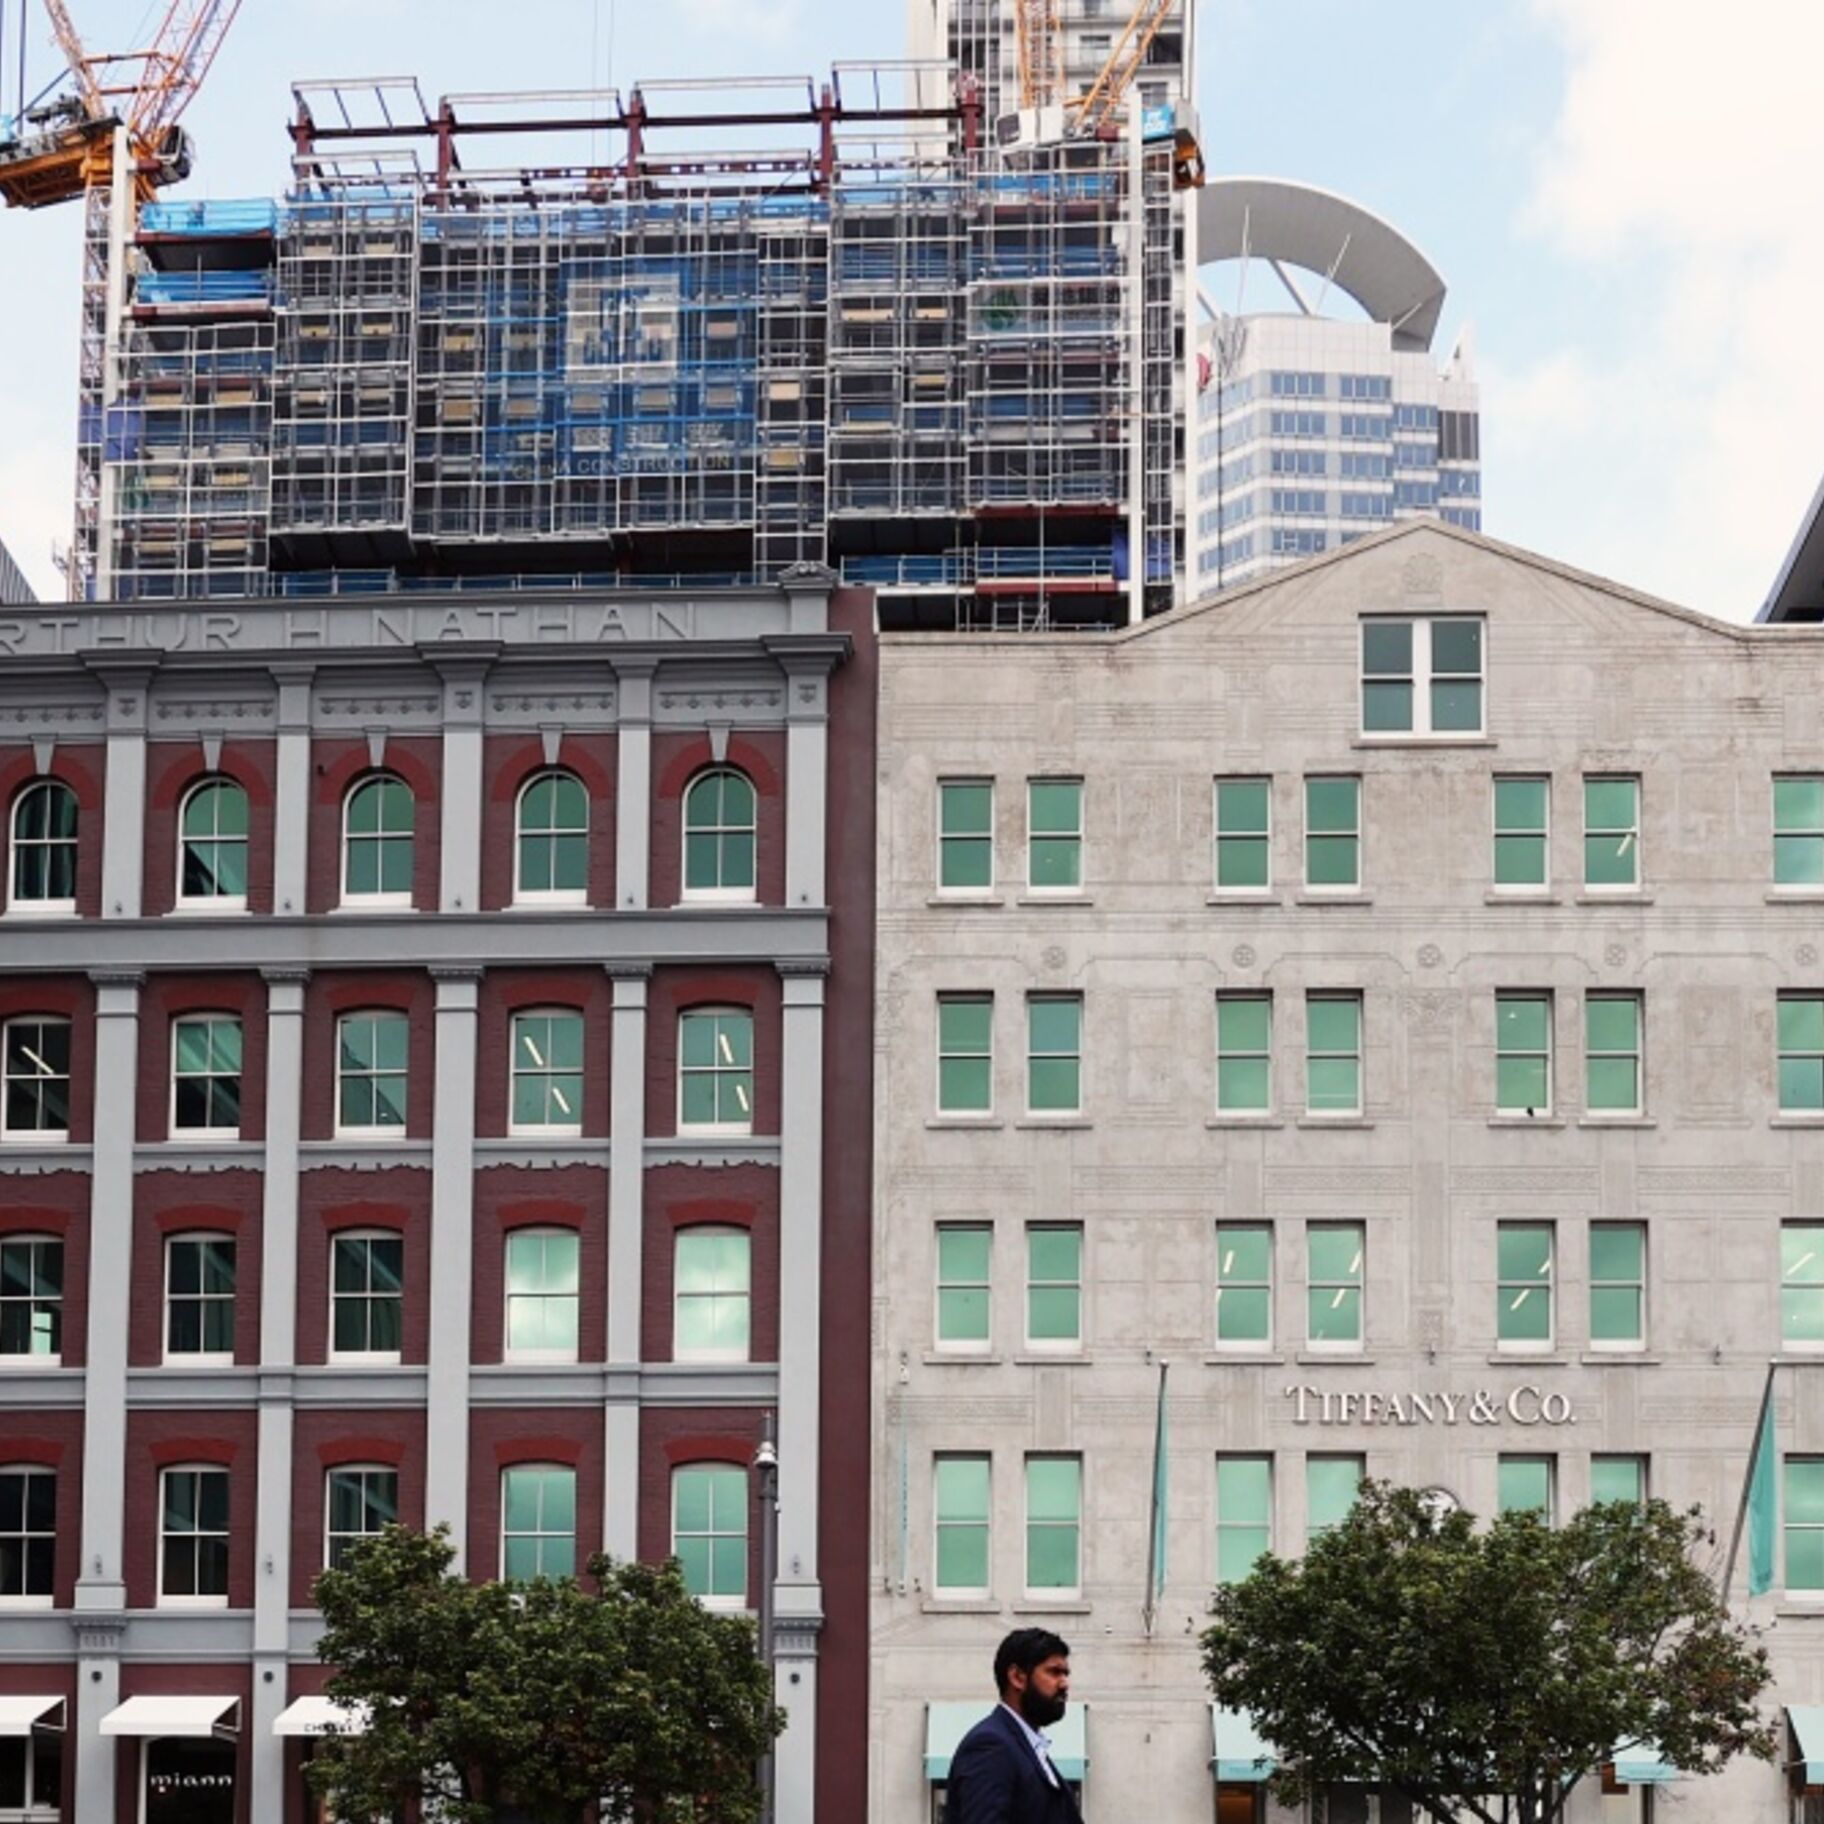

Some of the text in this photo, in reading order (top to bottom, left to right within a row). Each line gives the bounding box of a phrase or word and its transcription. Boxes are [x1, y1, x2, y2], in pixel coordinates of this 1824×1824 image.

[373, 602, 695, 645] NATHAN
[1284, 1386, 1465, 1424] TIFFANY
[151, 1772, 232, 1787] miann
